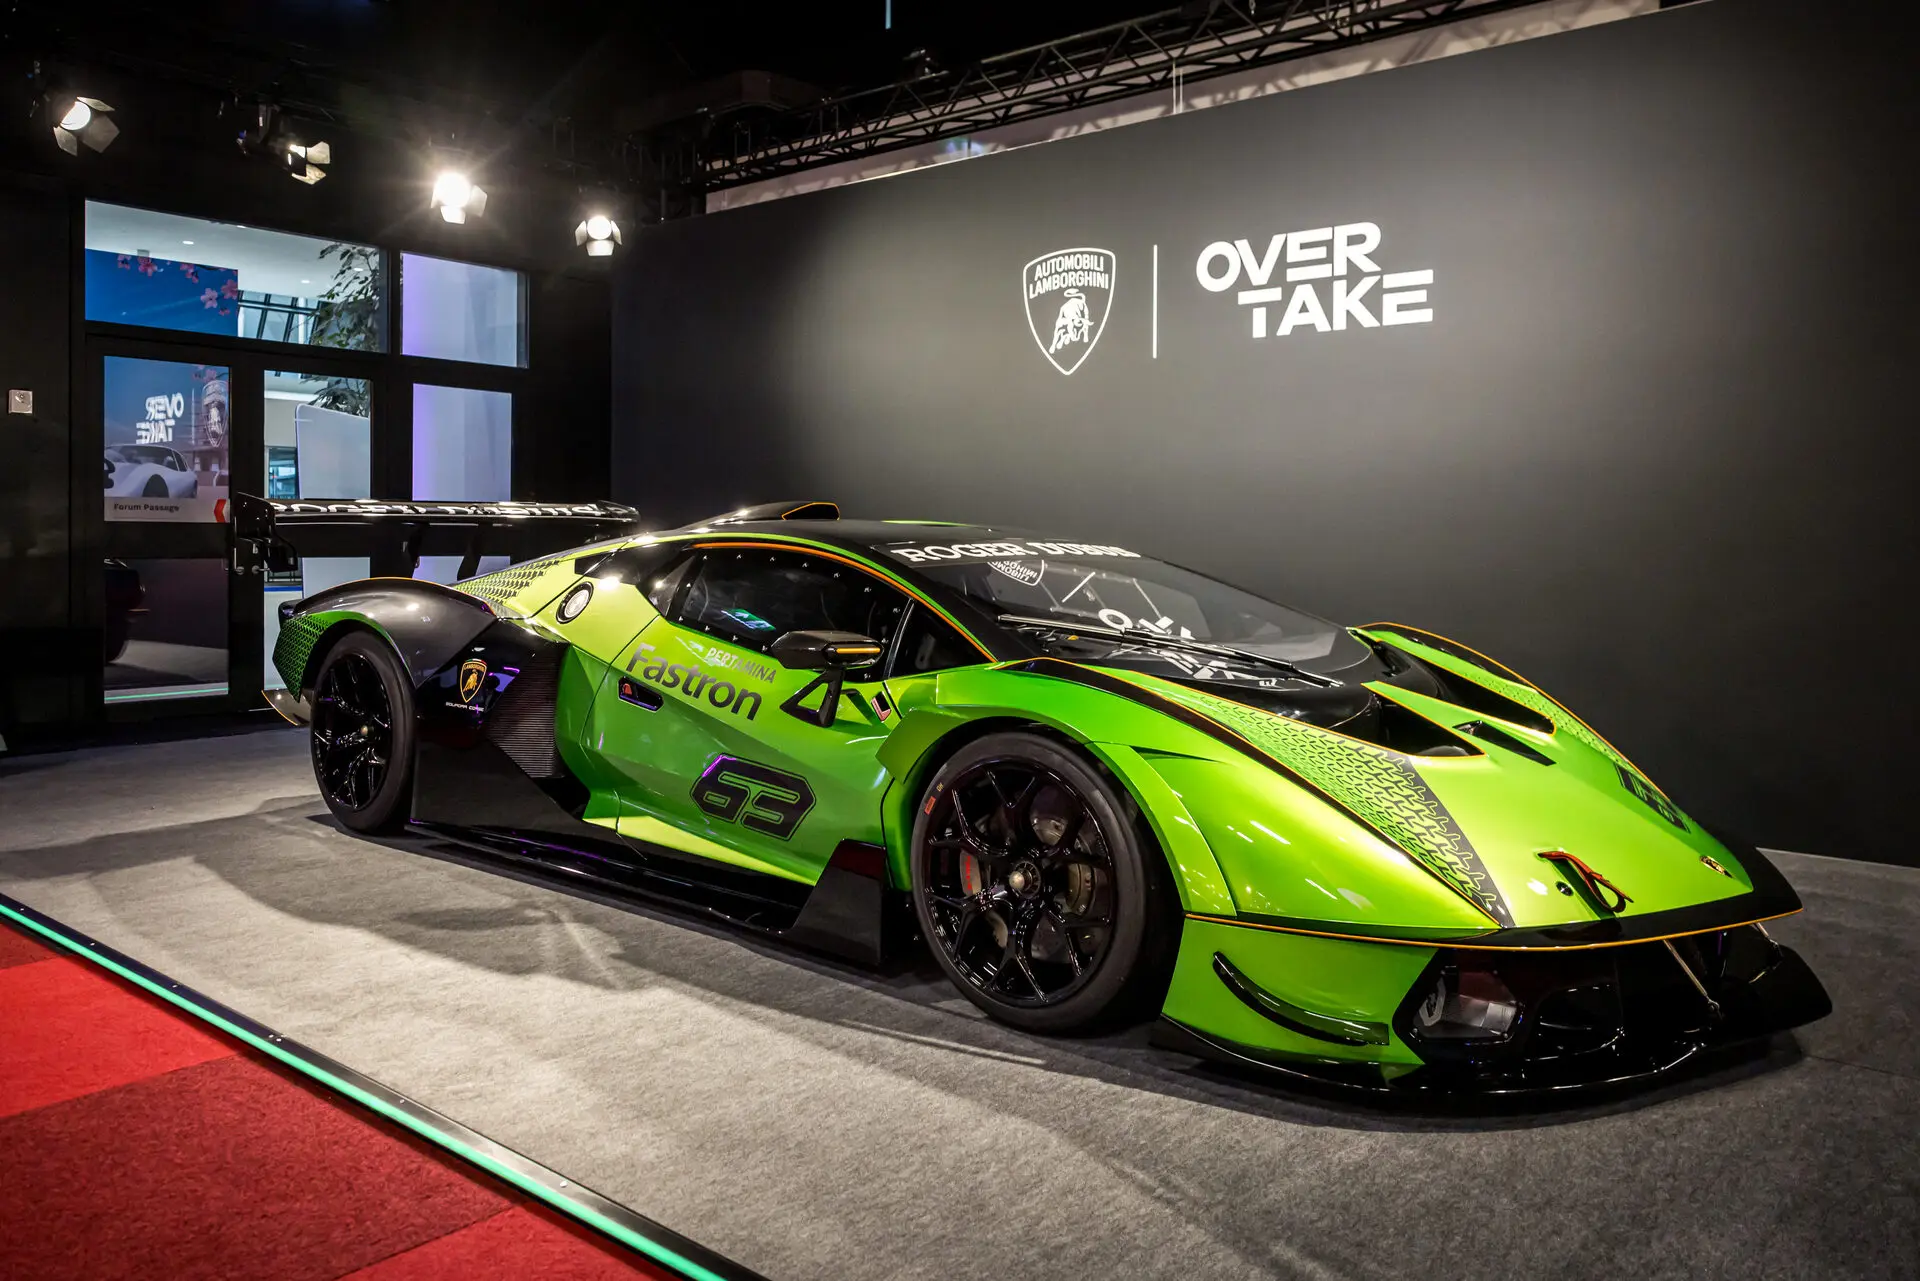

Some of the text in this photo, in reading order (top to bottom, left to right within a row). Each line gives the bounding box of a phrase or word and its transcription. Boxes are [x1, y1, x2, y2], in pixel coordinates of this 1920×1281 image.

[1034, 254, 1104, 281] AUTOMOBILI
[1196, 221, 1382, 292] OVER
[1029, 271, 1109, 299] LAMBORGHINI
[1237, 269, 1434, 339] TAKE
[113, 503, 180, 513] Forum Passage
[890, 542, 1040, 562] ROGER
[626, 642, 763, 721] Fastron
[706, 647, 777, 684] PERTAMINA
[689, 752, 817, 842] 63
